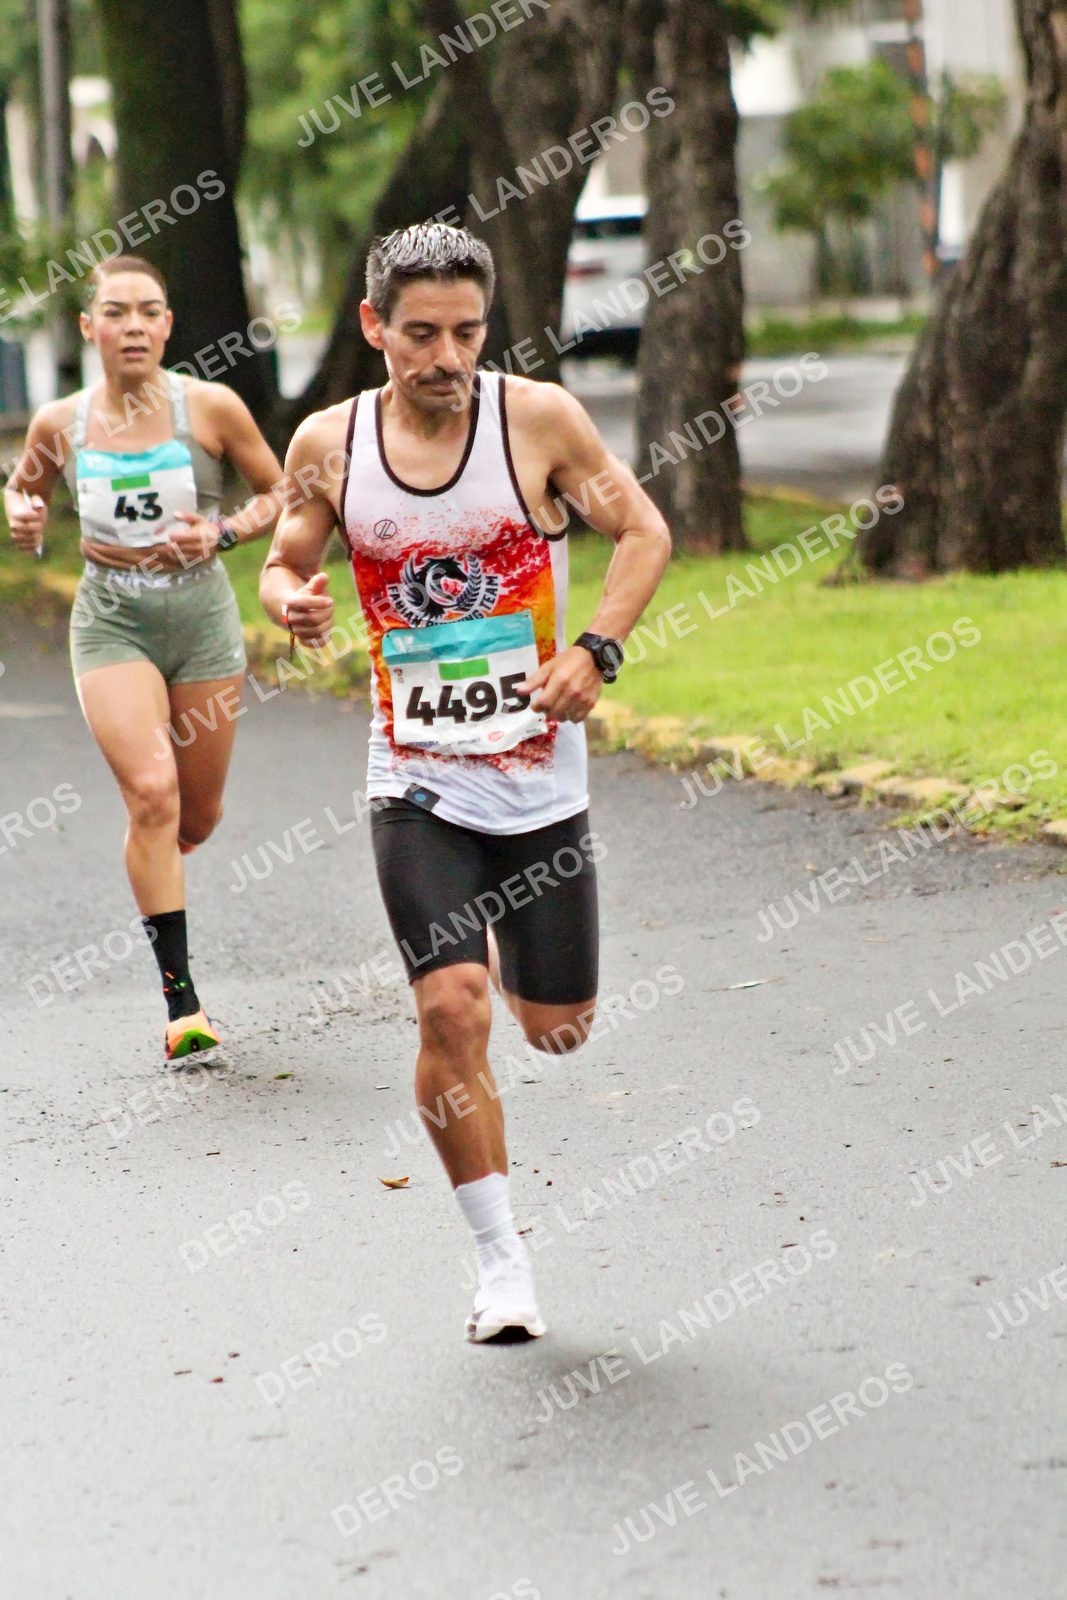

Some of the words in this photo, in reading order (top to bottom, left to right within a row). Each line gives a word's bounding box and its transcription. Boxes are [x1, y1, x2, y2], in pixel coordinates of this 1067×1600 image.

[114, 492, 163, 523] 43
[479, 575, 498, 610] TEAM
[406, 672, 531, 726] 4495
